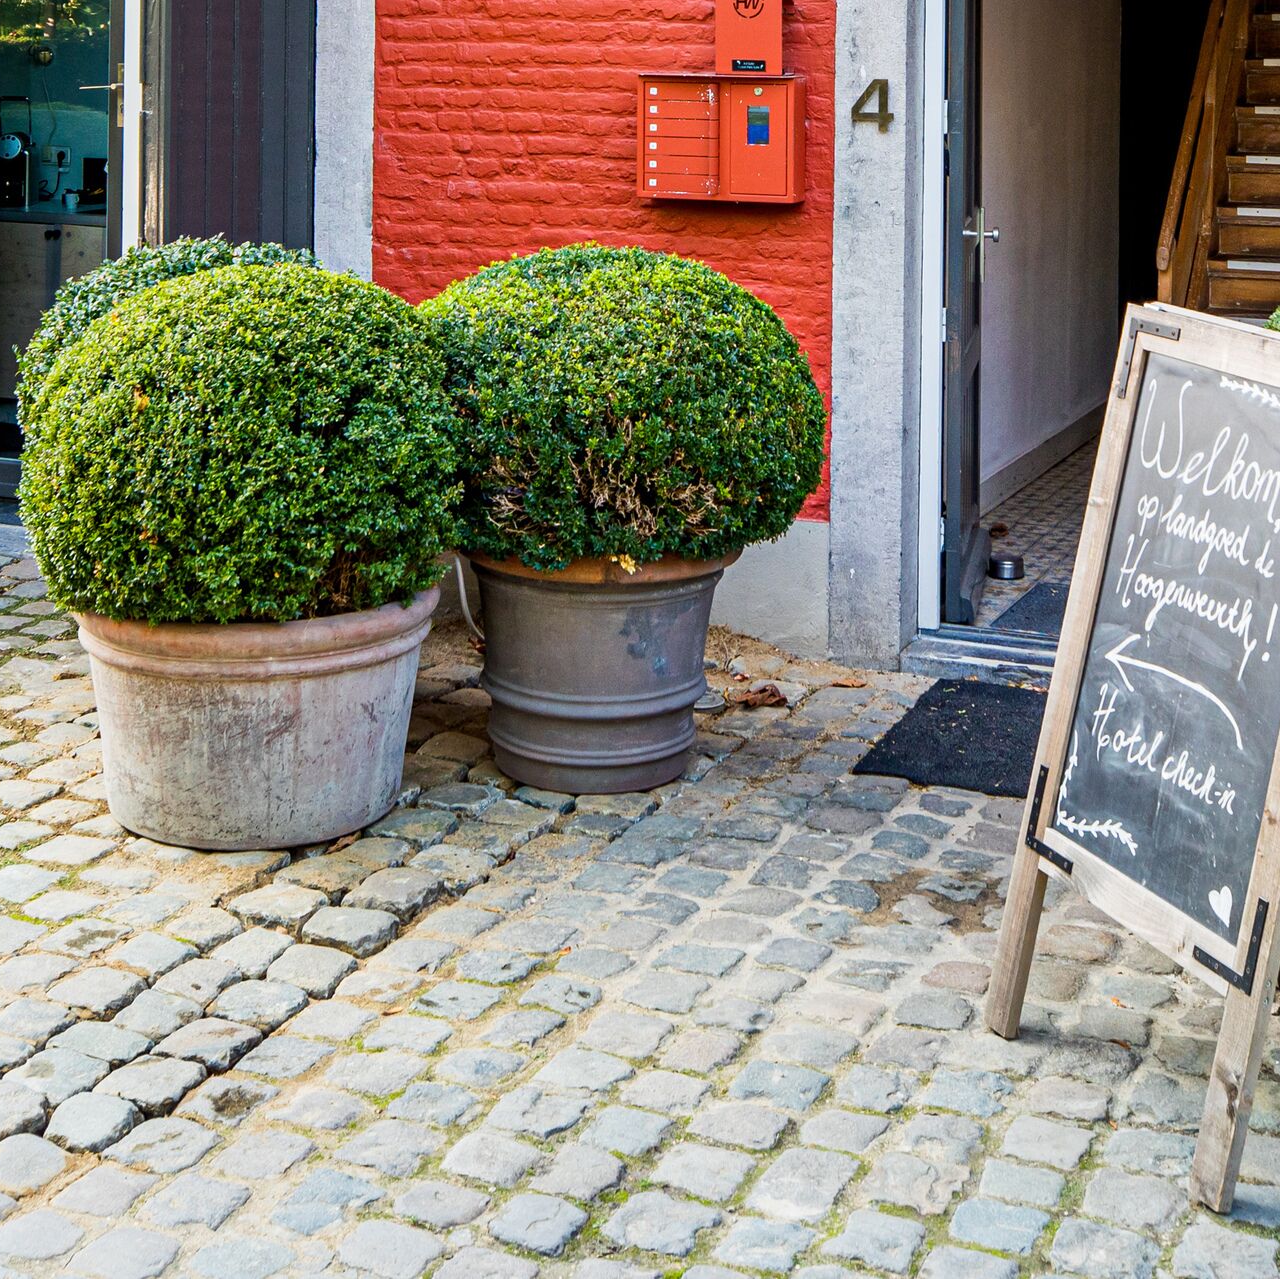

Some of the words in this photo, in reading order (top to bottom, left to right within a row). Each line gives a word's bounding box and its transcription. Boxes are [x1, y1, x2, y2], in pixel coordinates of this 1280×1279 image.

[851, 78, 895, 134] 4
[1137, 494, 1159, 537] op
[1161, 494, 1250, 576] landgoed
[1254, 539, 1274, 579] de
[1091, 682, 1164, 772] Hotel
[1161, 750, 1237, 815] check-in
